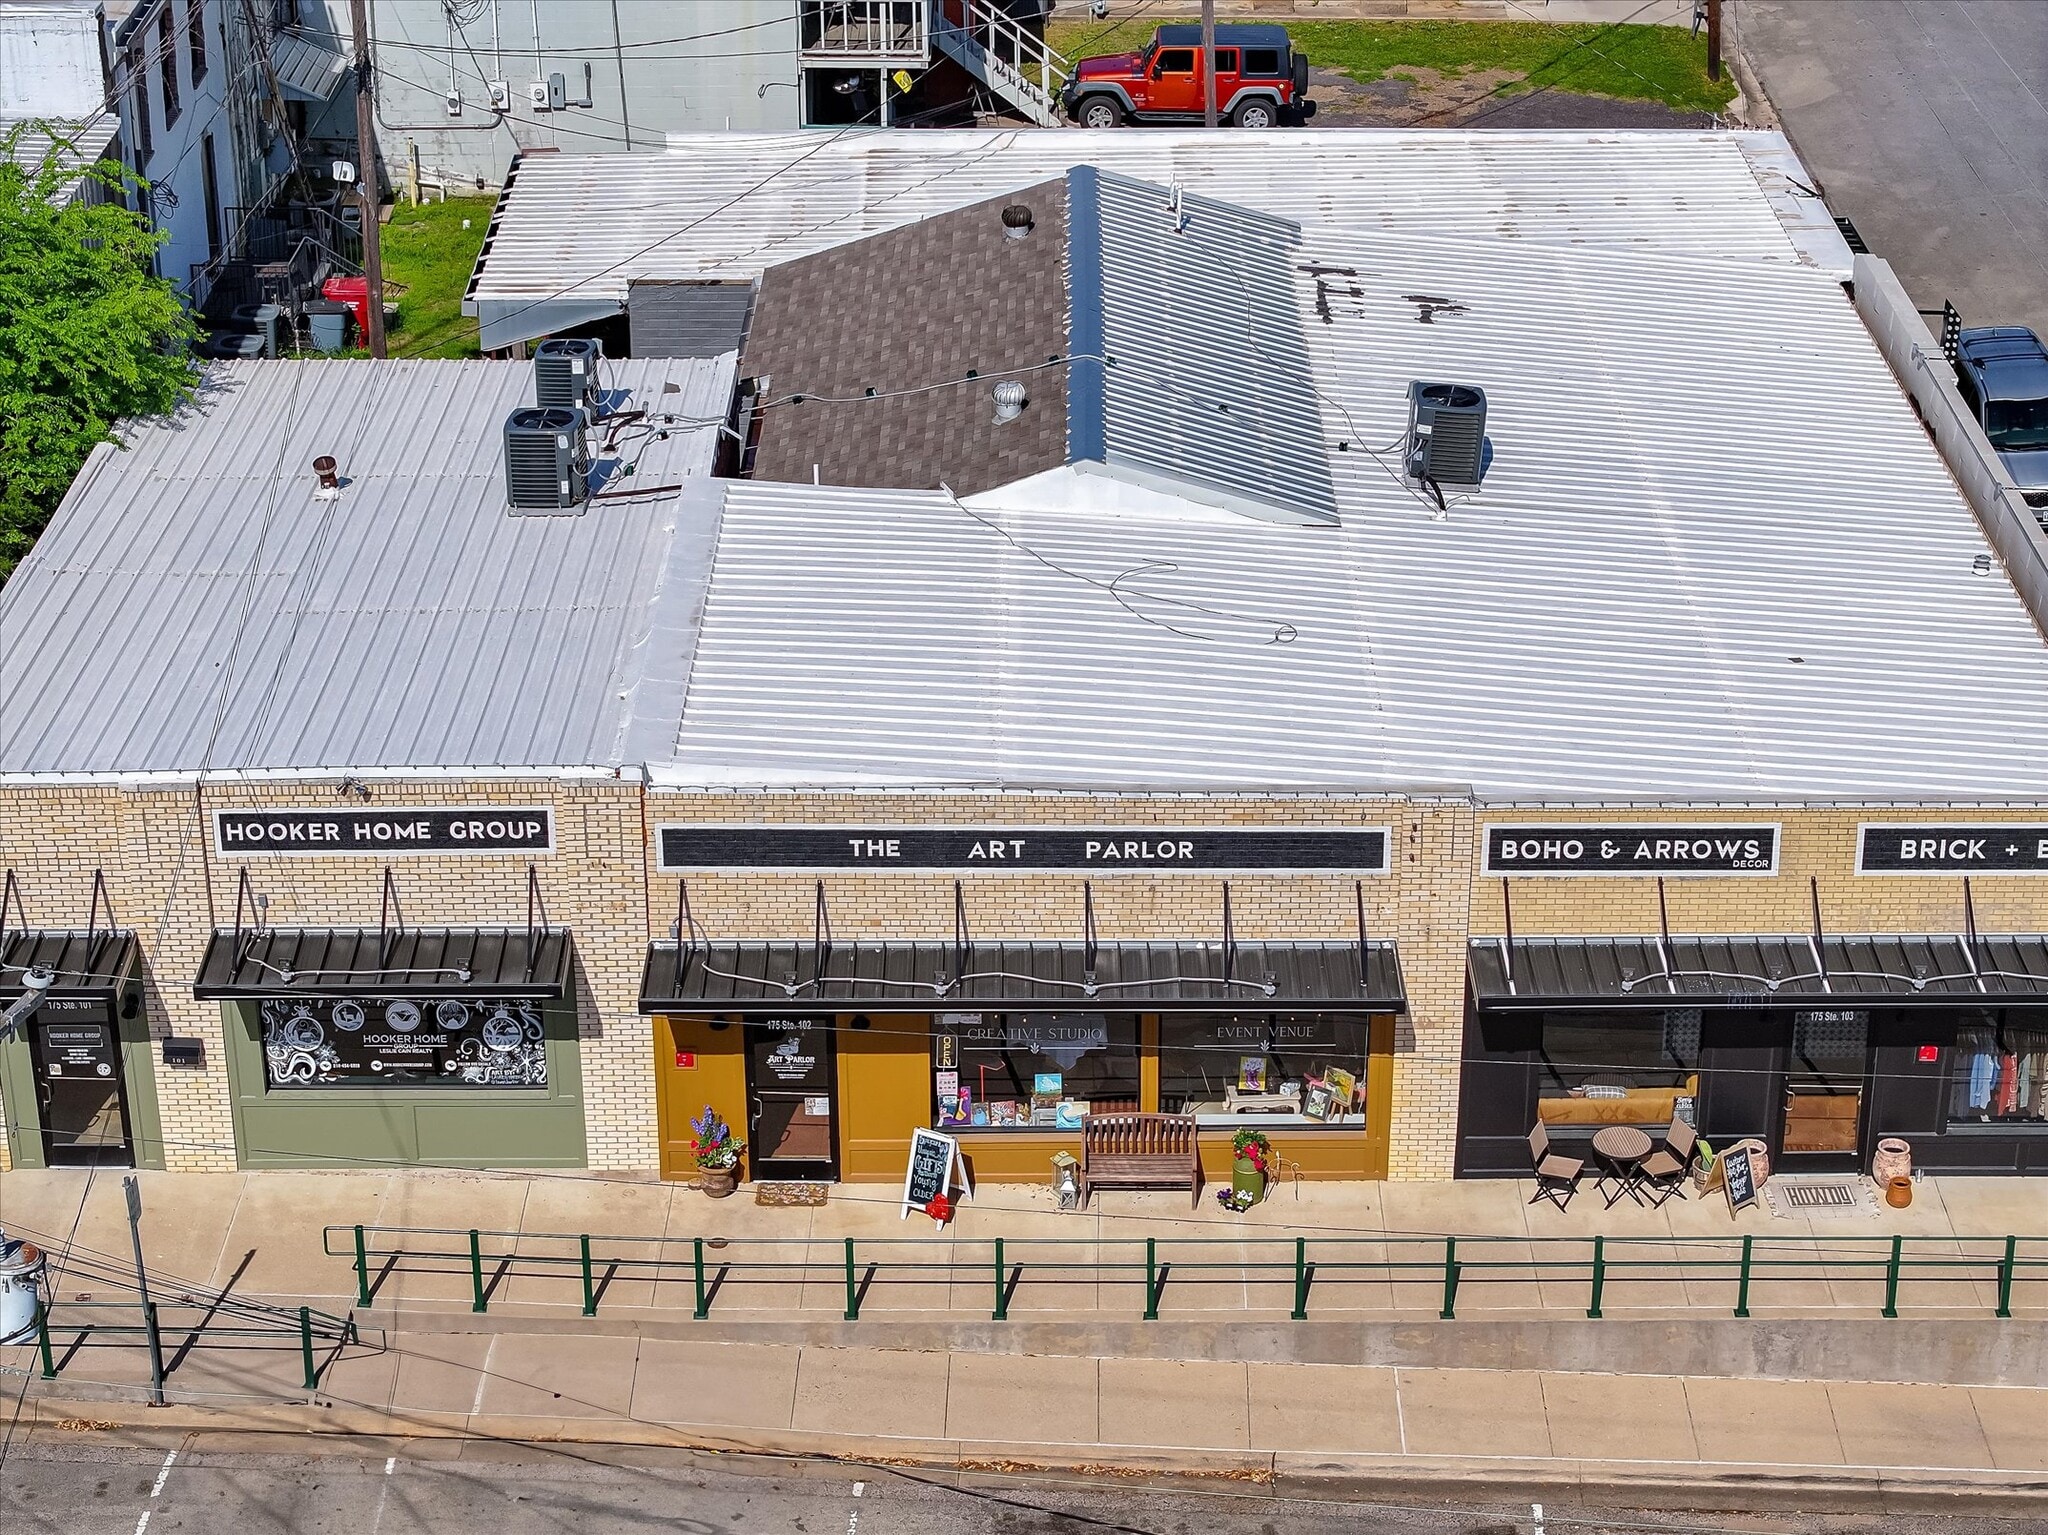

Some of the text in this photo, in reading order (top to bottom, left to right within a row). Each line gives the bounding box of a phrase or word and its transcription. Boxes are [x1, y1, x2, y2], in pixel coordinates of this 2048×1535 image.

[226, 820, 542, 842] HOOKER HOME GROUP
[848, 838, 1195, 860] THE ART PARLOR
[1501, 839, 1760, 860] BOHO & ARROWS
[1900, 838, 1987, 860] BRICK
[1732, 859, 1770, 869] DECOR
[62, 1001, 78, 1010] Ste.
[1810, 1011, 1854, 1021] 175 Ste. 103
[766, 1020, 812, 1030] 175 Ste. 102
[967, 1028, 1102, 1040] CREATIVE STUDIO
[1217, 1026, 1314, 1038] EVENT VENUE
[363, 1034, 448, 1043] HOOKER HOME
[943, 1036, 951, 1066] OPEN
[766, 1055, 815, 1064] ART PARLOR
[914, 1155, 943, 1174] GIFTS
[1786, 1187, 1852, 1206] HOWDY
